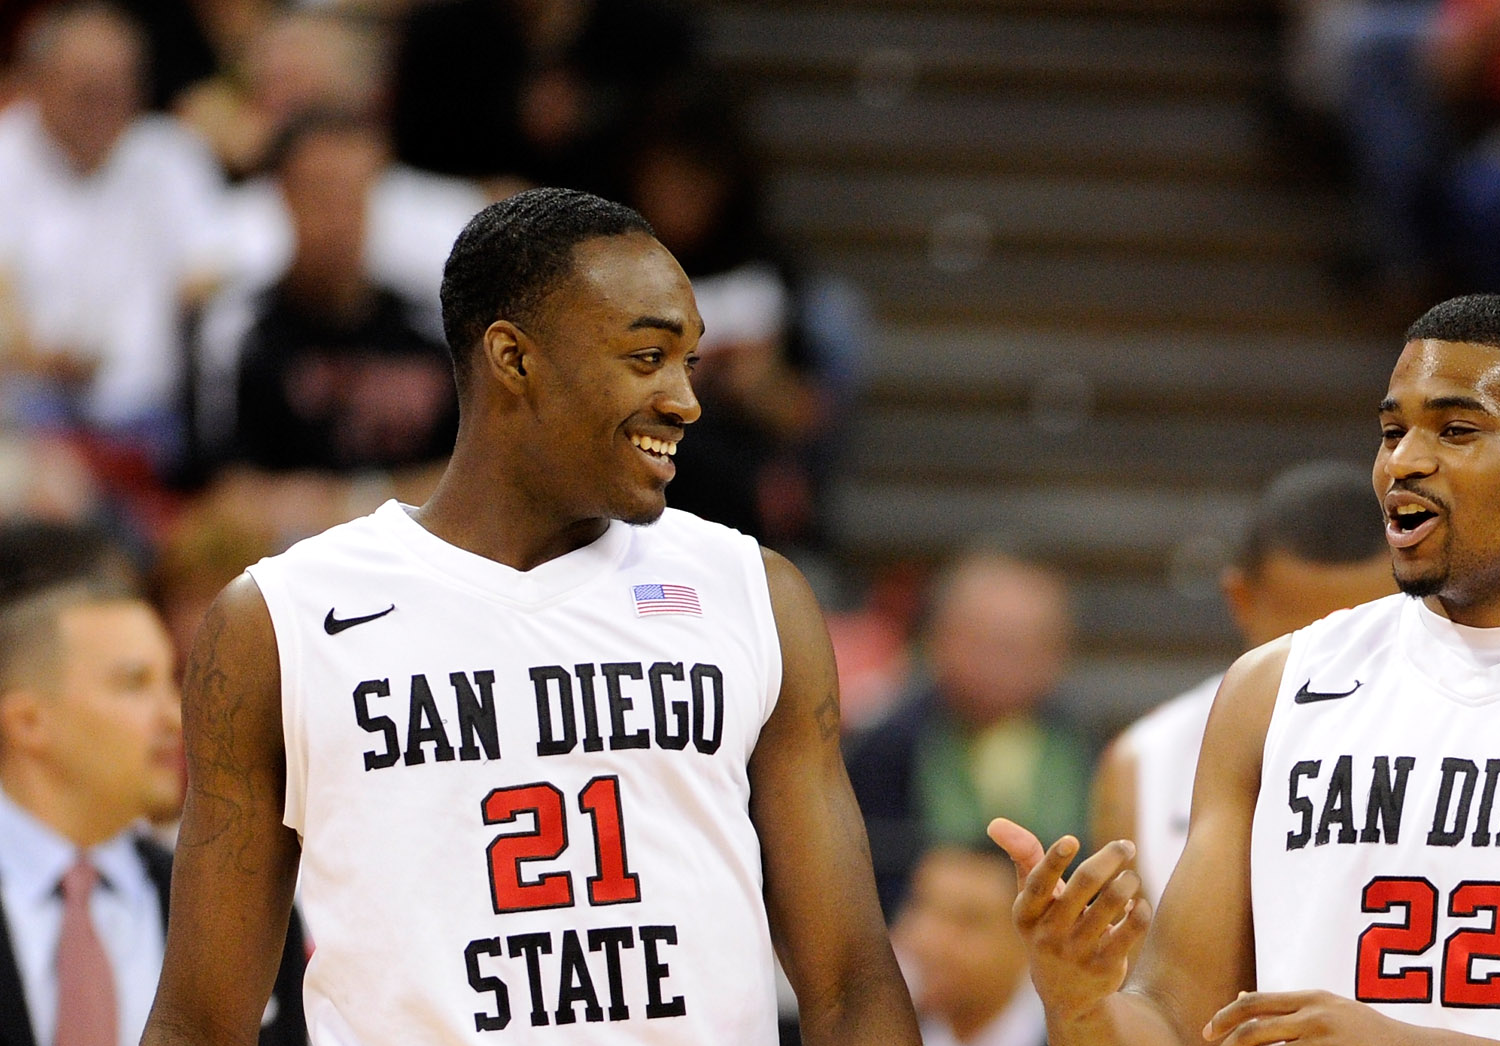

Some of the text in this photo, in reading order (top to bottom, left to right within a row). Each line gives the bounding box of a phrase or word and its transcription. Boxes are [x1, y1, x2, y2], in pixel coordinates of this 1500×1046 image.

[352, 661, 724, 772] SAN DIEGO
[480, 774, 642, 916] 21
[1286, 755, 1416, 851] SAN
[463, 925, 687, 1033] STATE
